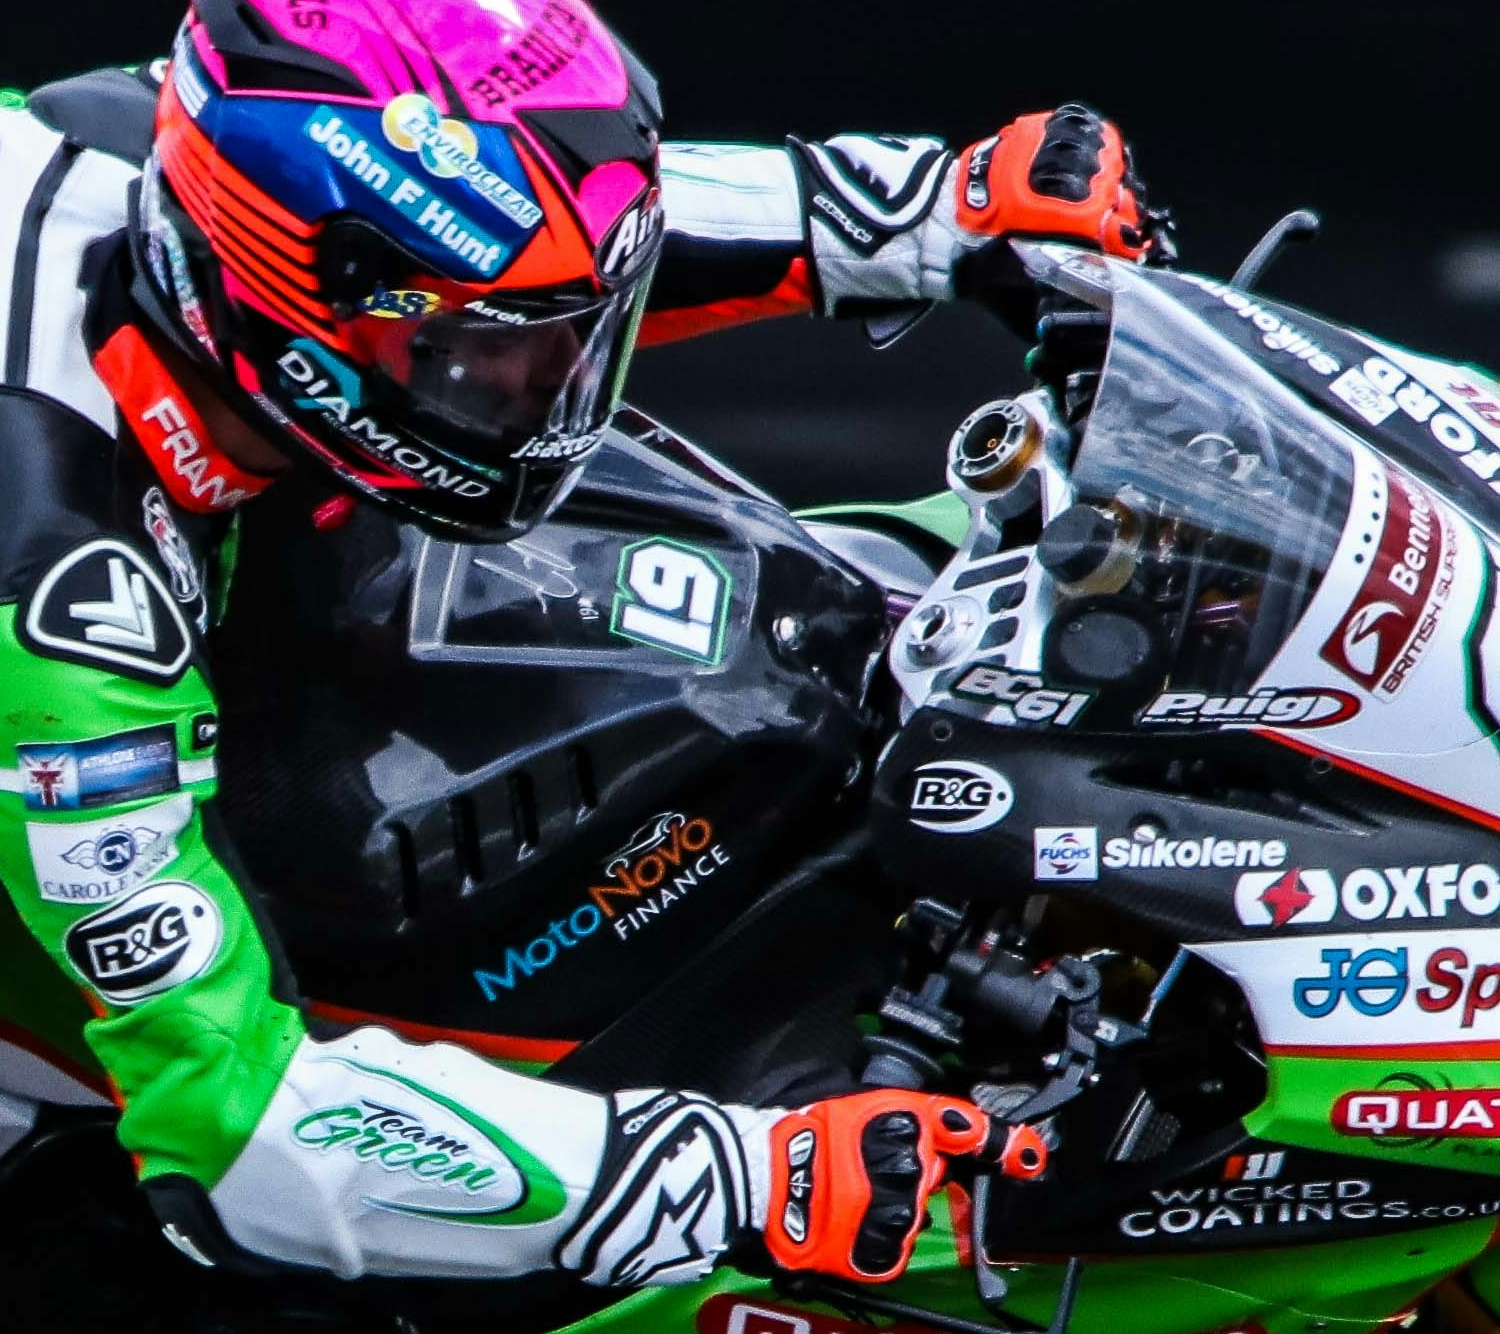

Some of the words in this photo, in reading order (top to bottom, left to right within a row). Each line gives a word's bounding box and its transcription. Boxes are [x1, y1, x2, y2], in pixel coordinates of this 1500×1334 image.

[309, 116, 390, 191] John
[387, 178, 425, 206] F
[416, 198, 501, 273] Hunt
[277, 350, 490, 498] DIAMOND
[1380, 604, 1443, 694] BRITISH
[1144, 687, 1320, 724] Puig
[913, 777, 992, 810] R&G
[1040, 844, 1091, 862] FUCHS
[614, 842, 731, 943] FINANCE
[86, 901, 188, 978] R&G
[295, 1106, 496, 1192] Green
[361, 1099, 469, 1158] Team
[1151, 1179, 1372, 1206] WICKED
